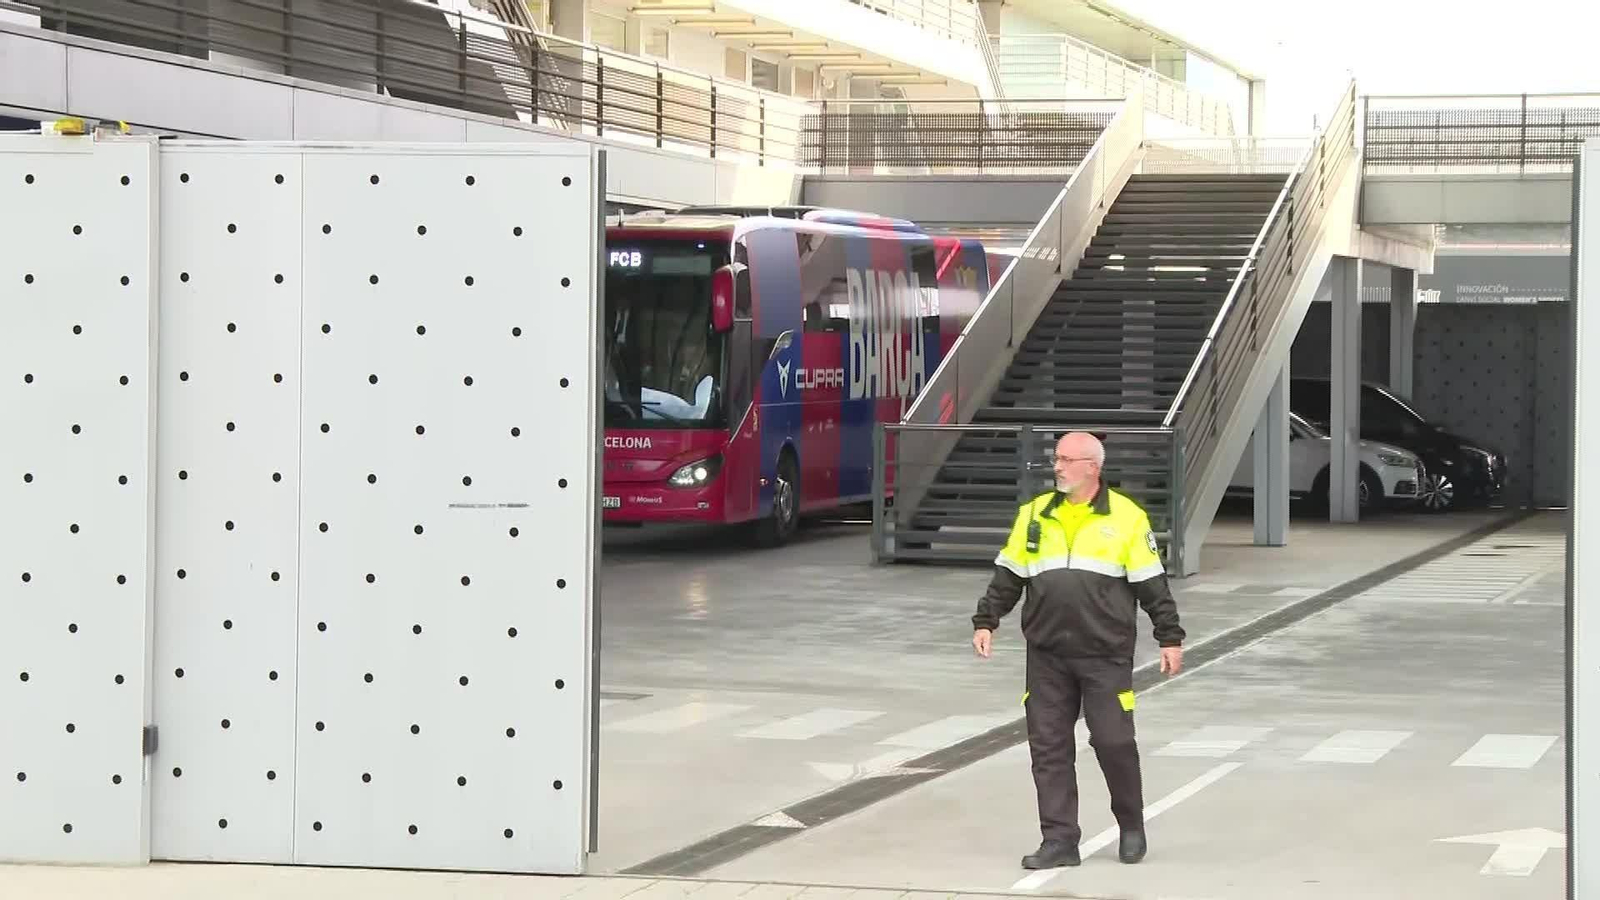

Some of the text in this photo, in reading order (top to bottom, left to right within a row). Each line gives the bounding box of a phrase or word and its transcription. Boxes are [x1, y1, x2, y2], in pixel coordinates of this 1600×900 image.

[610, 251, 642, 267] FCB
[847, 268, 926, 417] BARÇA
[795, 368, 844, 389] CUPRA
[604, 437, 652, 449] CELONA
